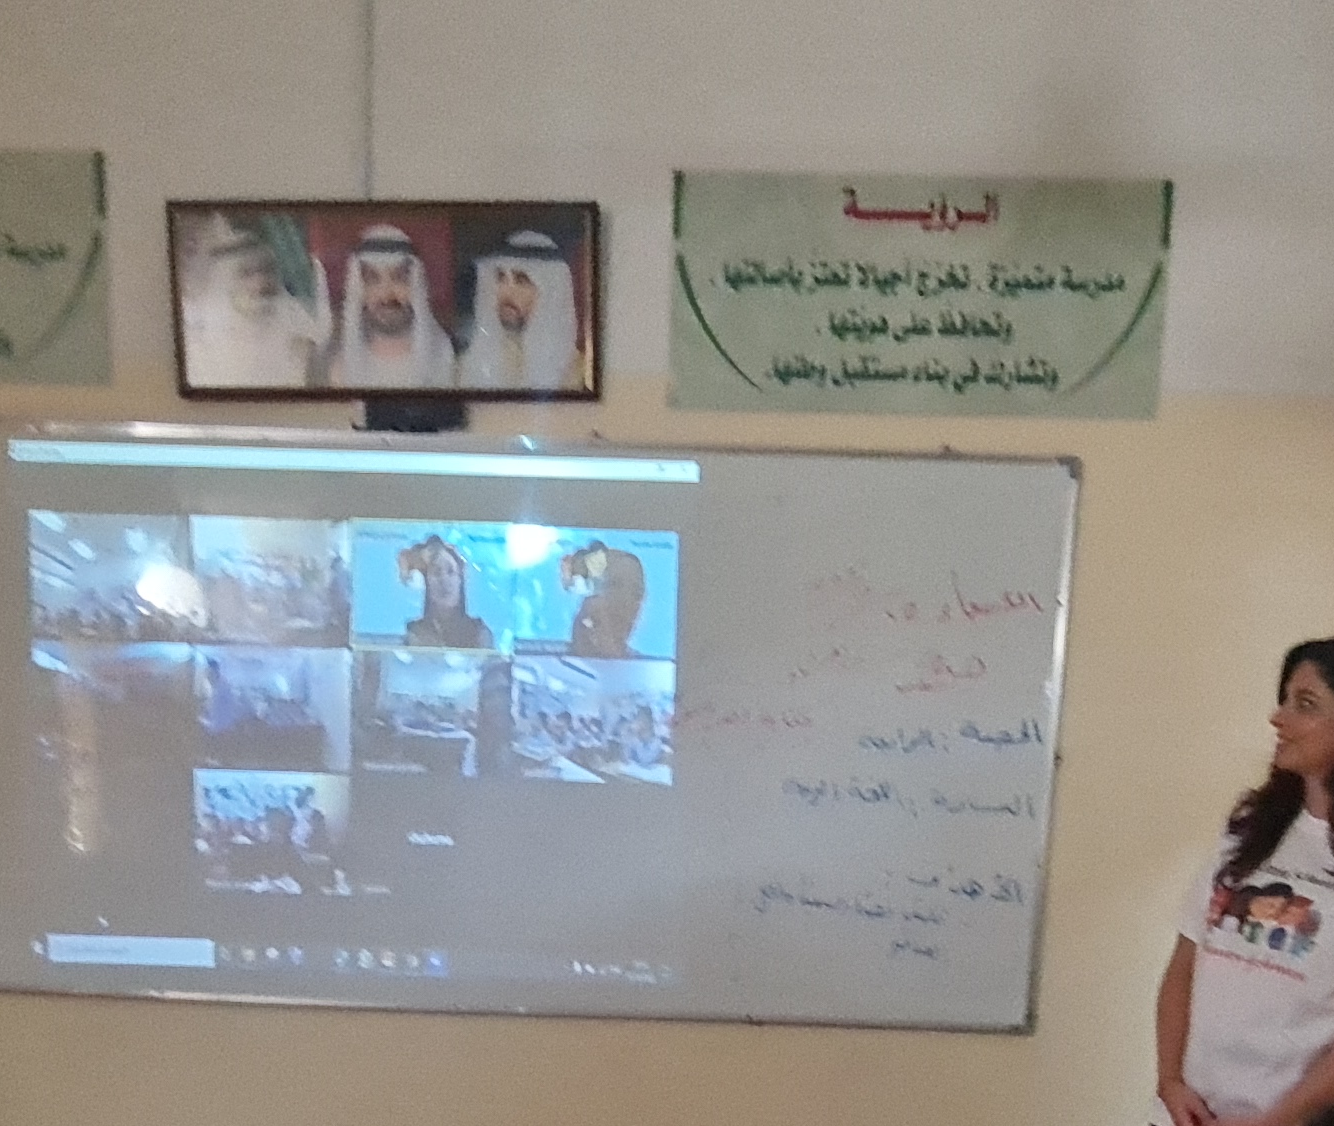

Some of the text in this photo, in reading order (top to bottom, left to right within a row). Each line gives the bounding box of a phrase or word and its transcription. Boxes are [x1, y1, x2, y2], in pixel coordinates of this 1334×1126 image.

[843, 184, 1000, 232] الرؤية
[1059, 263, 1126, 299] مدرسة
[892, 310, 933, 344] على
[937, 309, 1014, 347] وتحافظ
[830, 353, 909, 390] مستقبل
[953, 357, 981, 395] في
[983, 355, 1060, 393] وتشارك
